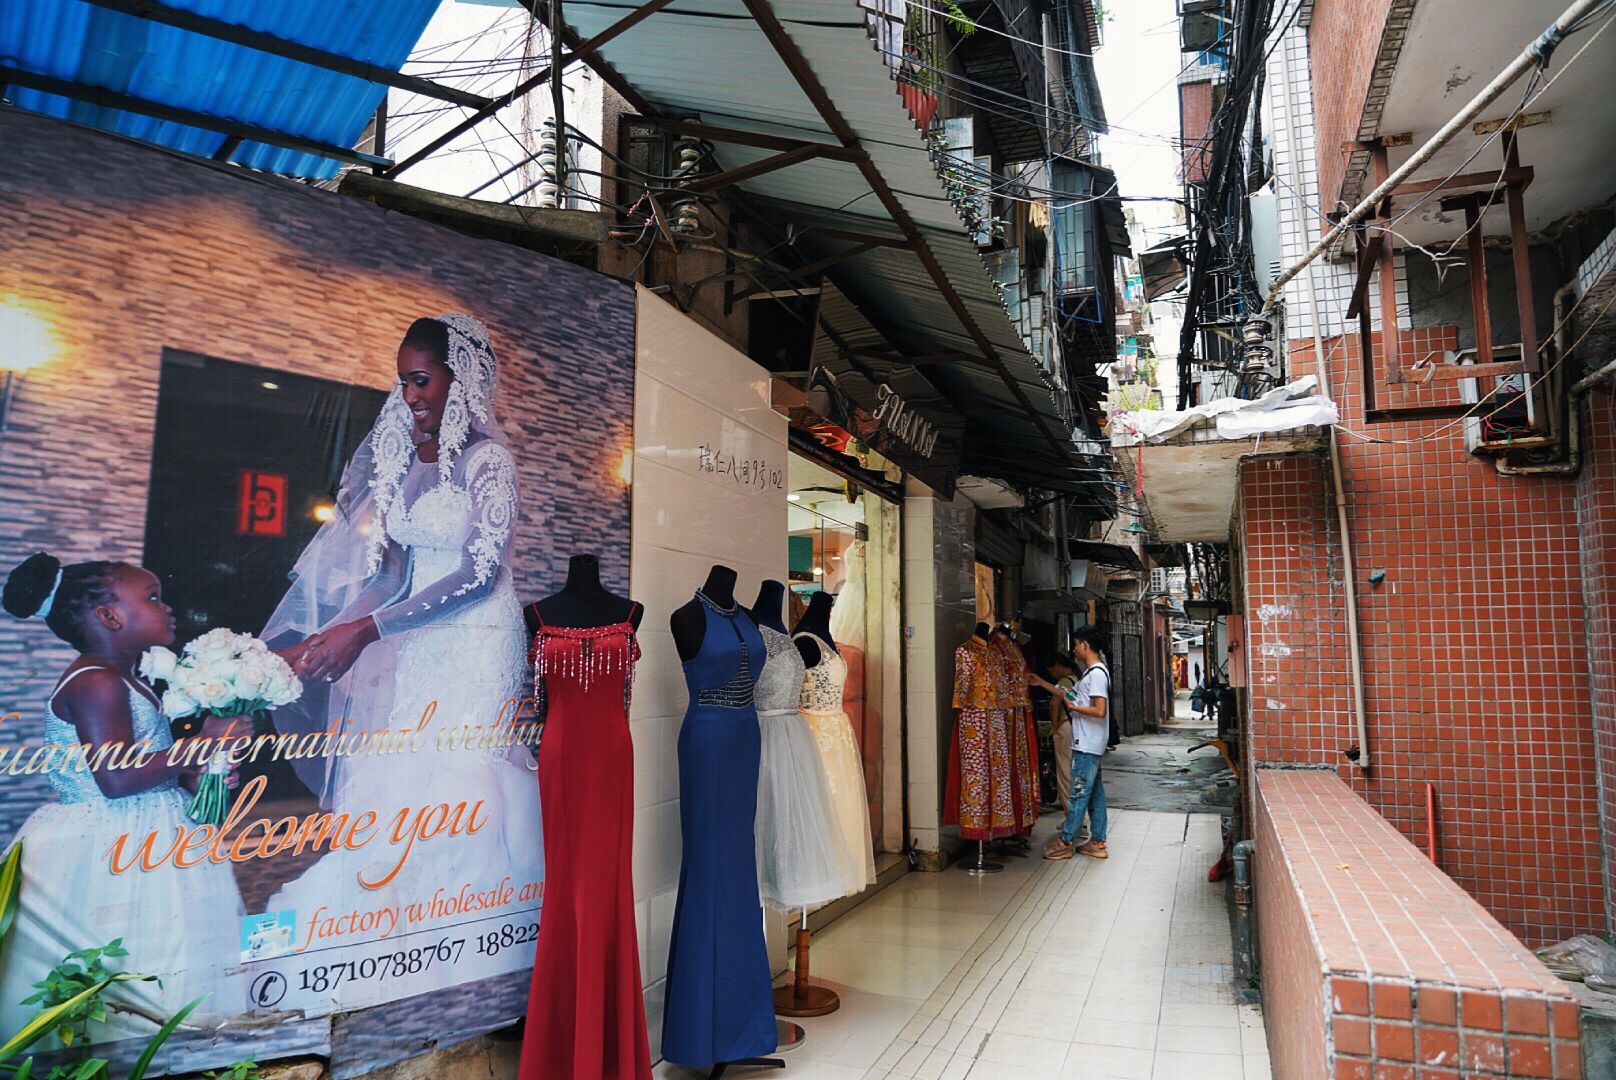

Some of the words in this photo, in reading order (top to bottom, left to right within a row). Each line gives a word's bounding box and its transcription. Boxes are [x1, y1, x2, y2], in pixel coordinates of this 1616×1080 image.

[0, 711, 156, 776] uanna
[165, 701, 438, 767] international
[434, 698, 545, 771] weddin
[103, 775, 380, 875] welcome
[358, 798, 490, 889] you
[296, 906, 399, 953] factory
[405, 876, 514, 923] wholesale
[298, 936, 466, 992] 18710788767
